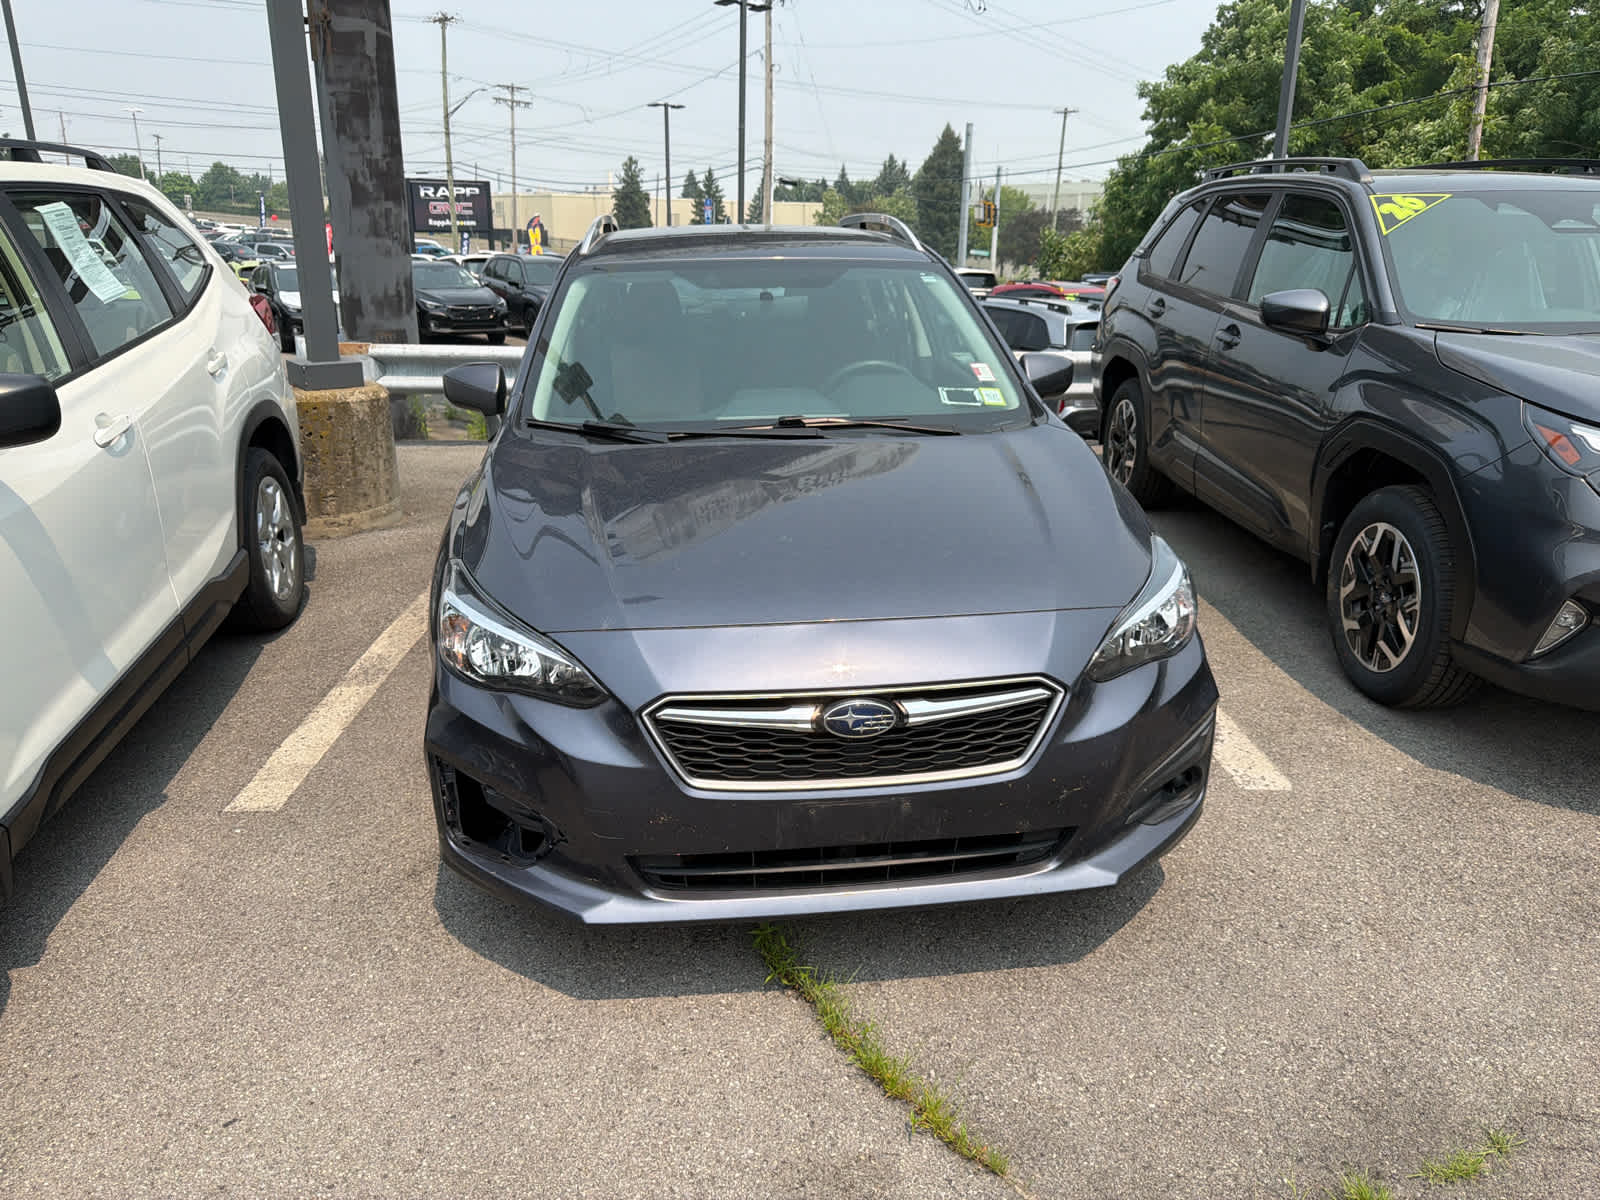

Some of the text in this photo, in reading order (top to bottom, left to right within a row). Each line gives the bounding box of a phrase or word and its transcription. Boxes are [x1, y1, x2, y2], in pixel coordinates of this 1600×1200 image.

[419, 185, 480, 197] RAPP
[429, 201, 473, 215] GMC
[1378, 195, 1427, 220] 26
